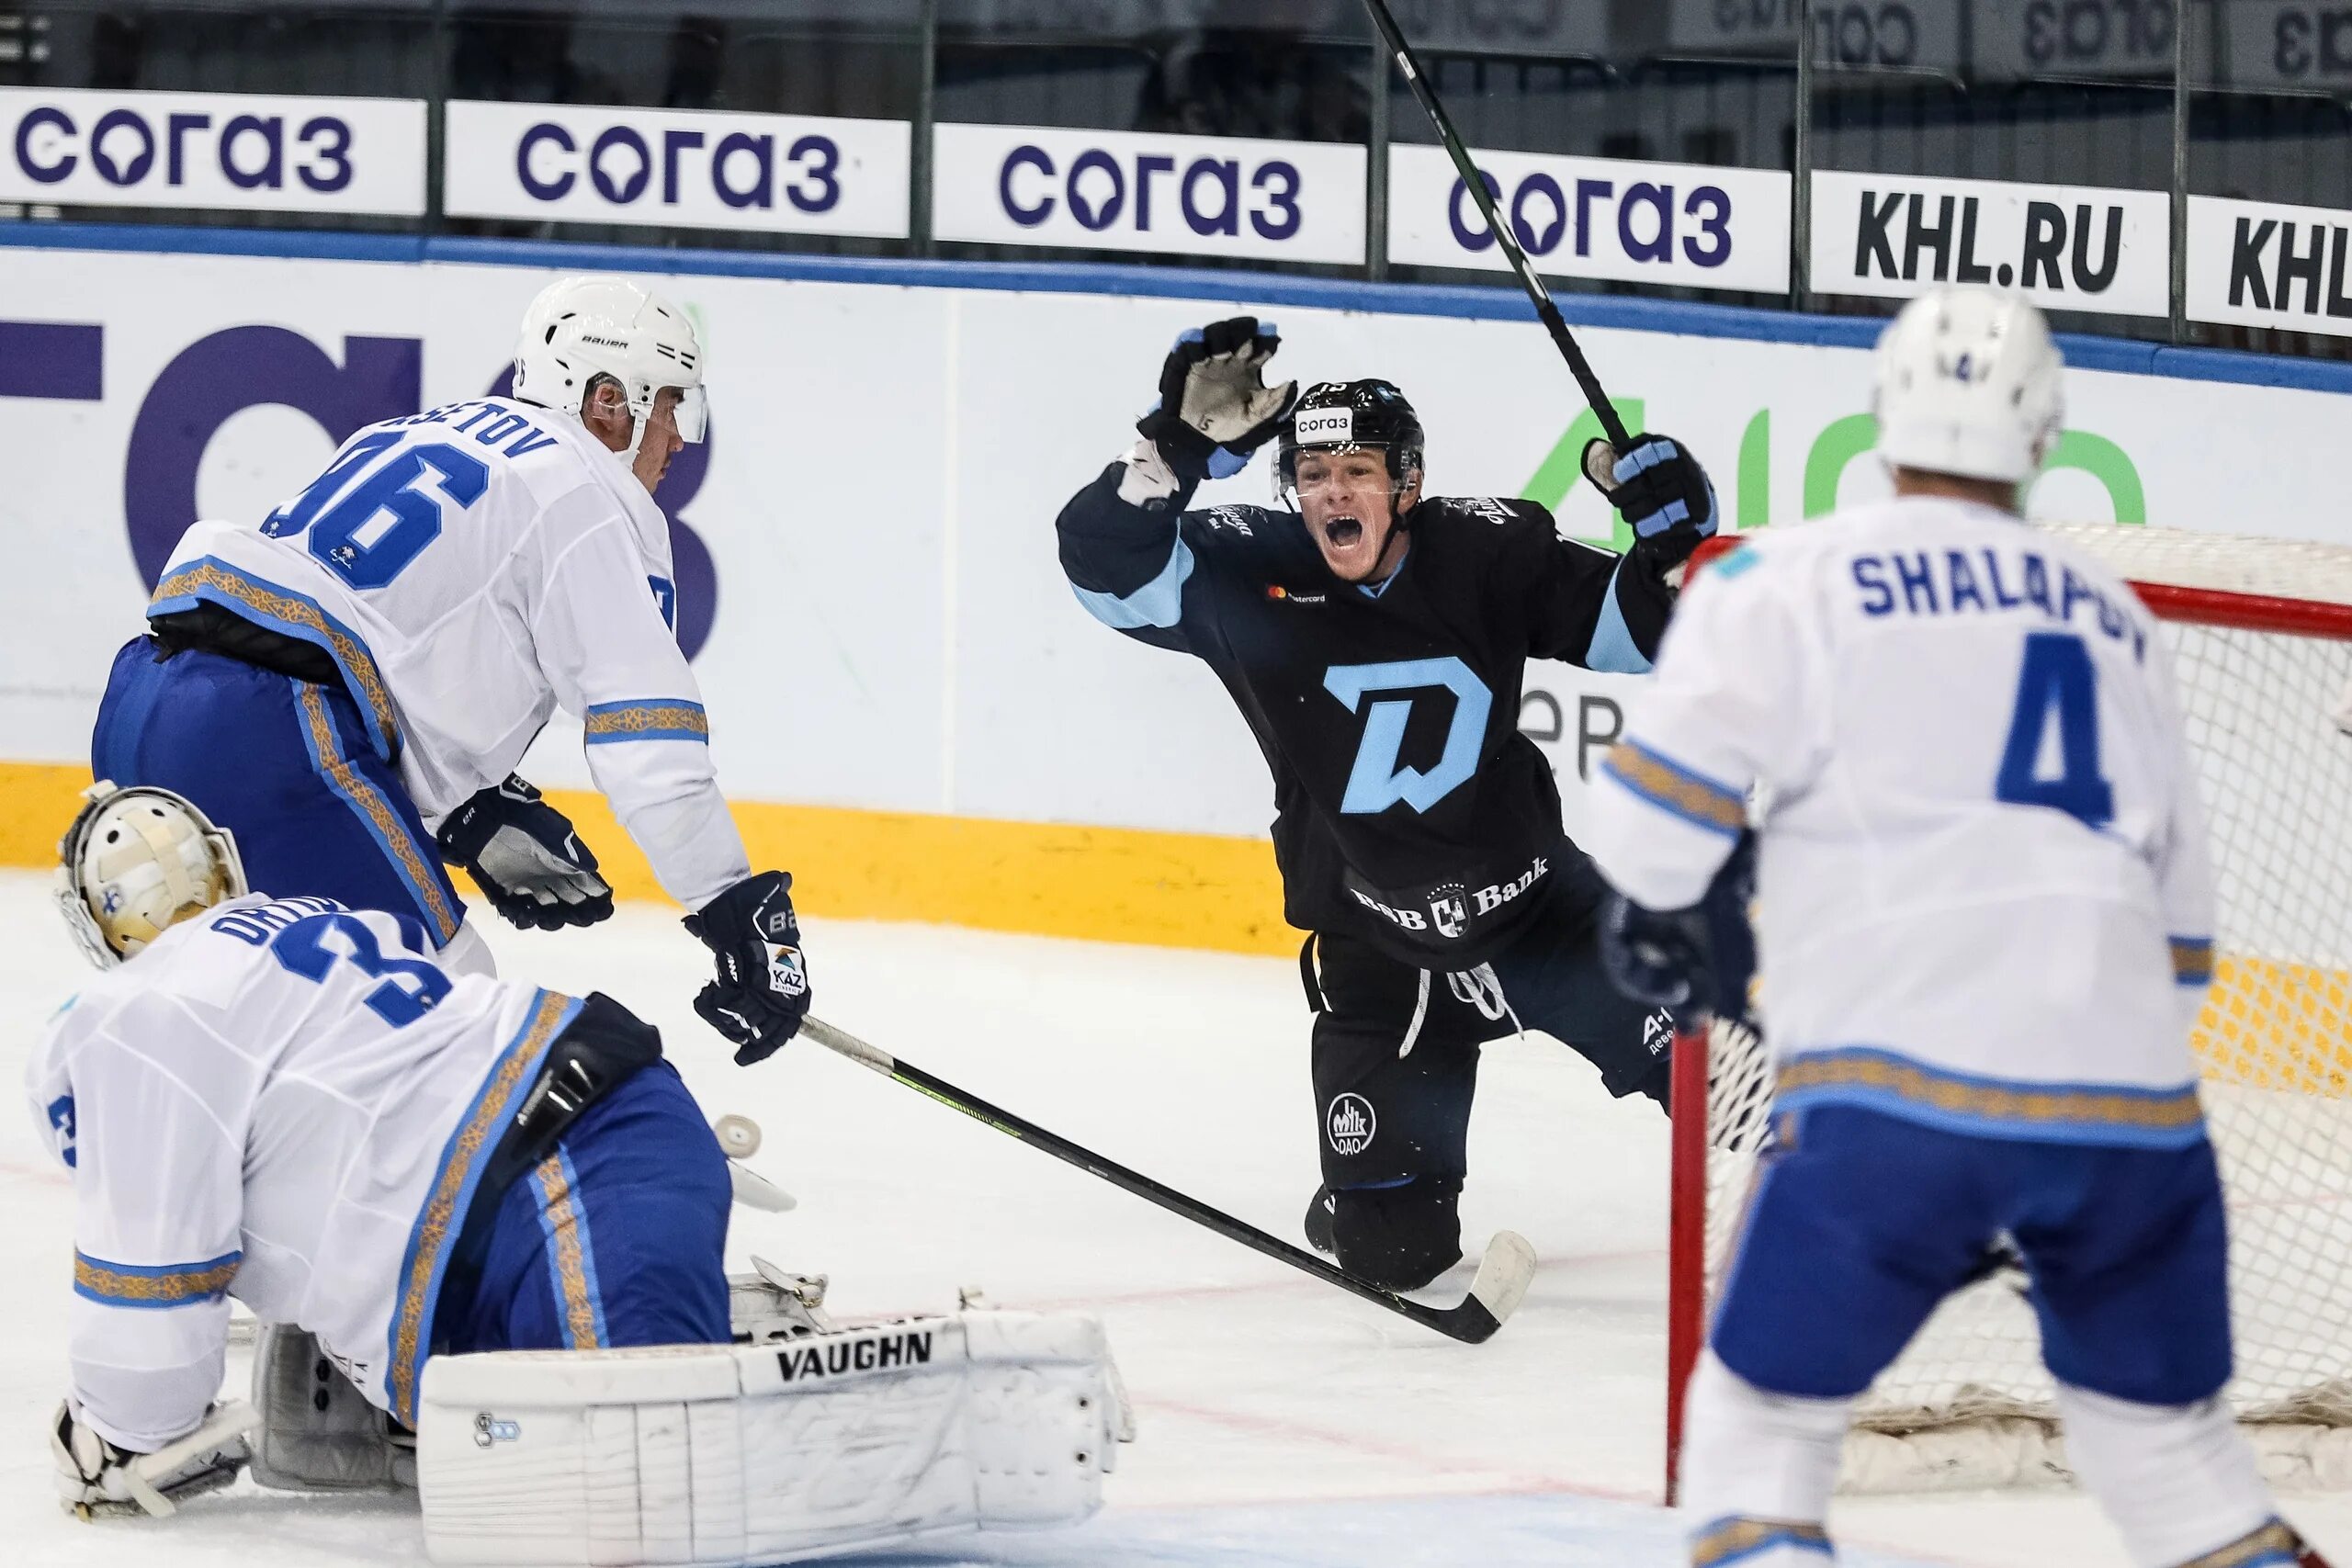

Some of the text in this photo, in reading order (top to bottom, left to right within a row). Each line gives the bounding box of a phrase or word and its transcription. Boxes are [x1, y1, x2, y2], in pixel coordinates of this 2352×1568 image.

[15, 107, 354, 193] согаз
[517, 122, 840, 214] согаз
[1000, 145, 1302, 242] согаз
[1449, 169, 1733, 268] согаз
[1854, 191, 2123, 293] KHL.RU
[582, 334, 629, 349] BAUER
[379, 401, 560, 458] SETOV
[1298, 417, 1349, 433] согаз
[1996, 634, 2112, 829] 4
[1472, 857, 1549, 917] Bank
[773, 969, 802, 989] KAZ
[777, 1331, 933, 1382] VAUGHN
